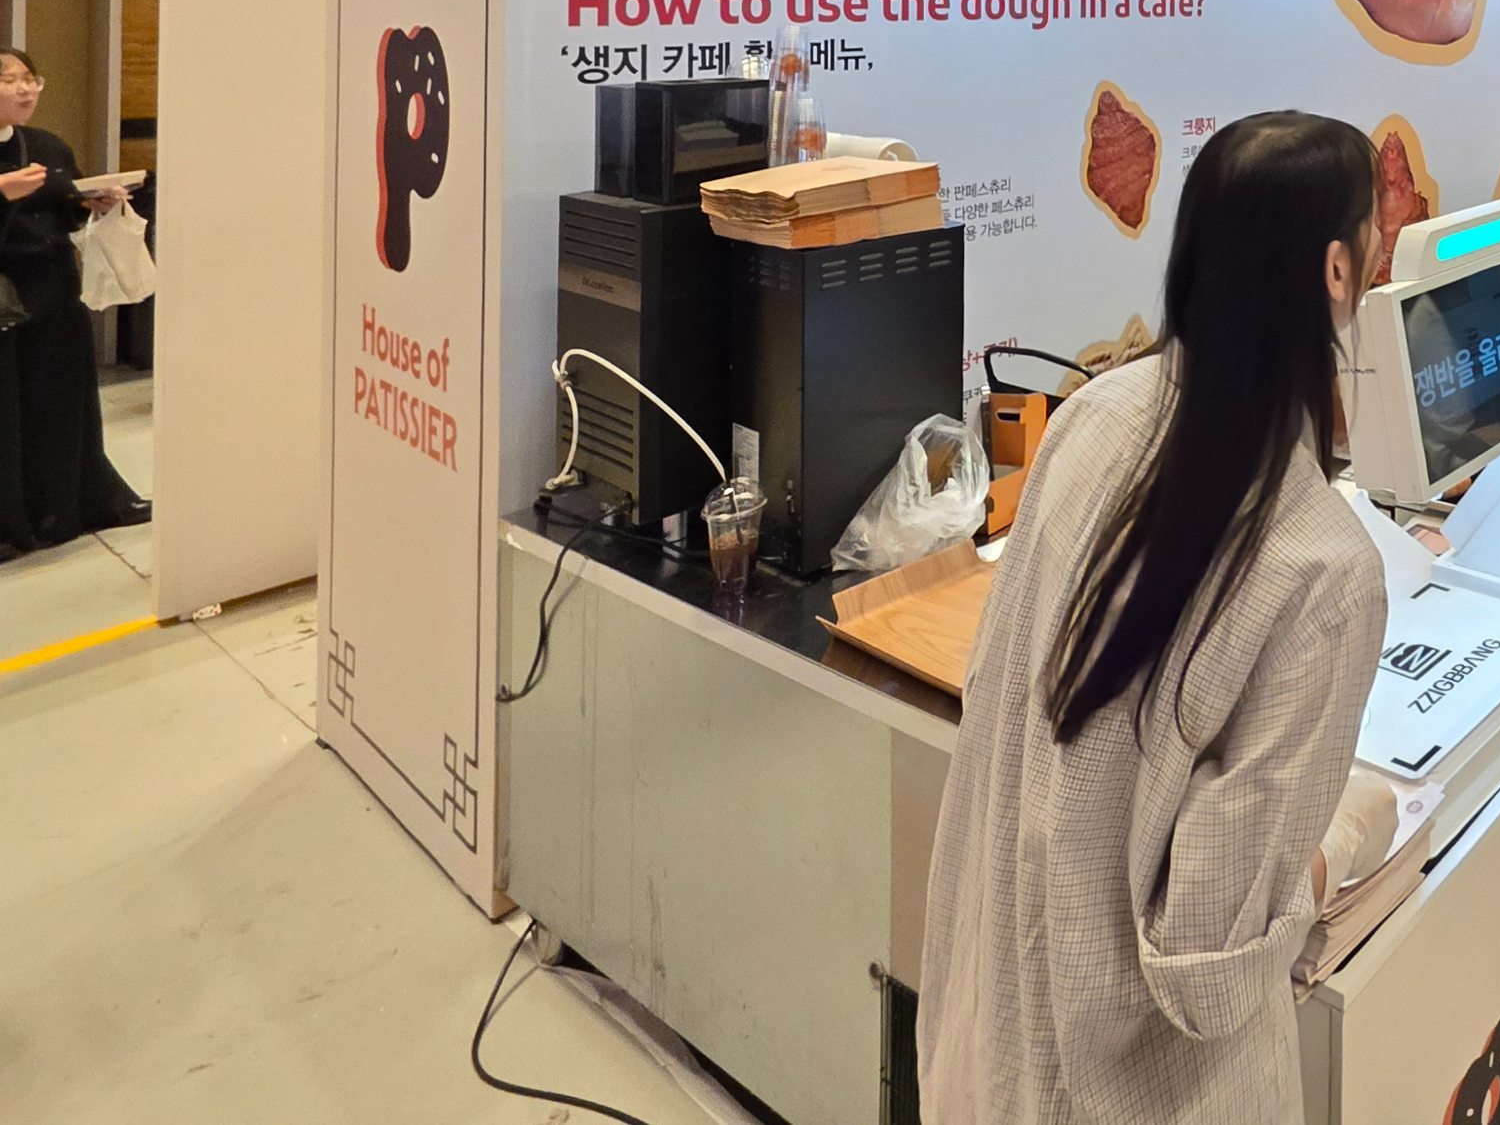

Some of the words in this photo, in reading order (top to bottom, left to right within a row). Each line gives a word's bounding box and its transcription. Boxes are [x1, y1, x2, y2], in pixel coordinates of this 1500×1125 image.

[662, 42, 730, 78] 카페
[953, 177, 1011, 201] 판페스츄리
[954, 202, 989, 221] 다양한
[991, 194, 1035, 215] 페스츄리
[980, 214, 1038, 237] 가능합니다.
[361, 302, 422, 380] House
[426, 337, 451, 393] of
[1413, 348, 1475, 408] 쟁반을
[354, 365, 459, 473] PATISSIER
